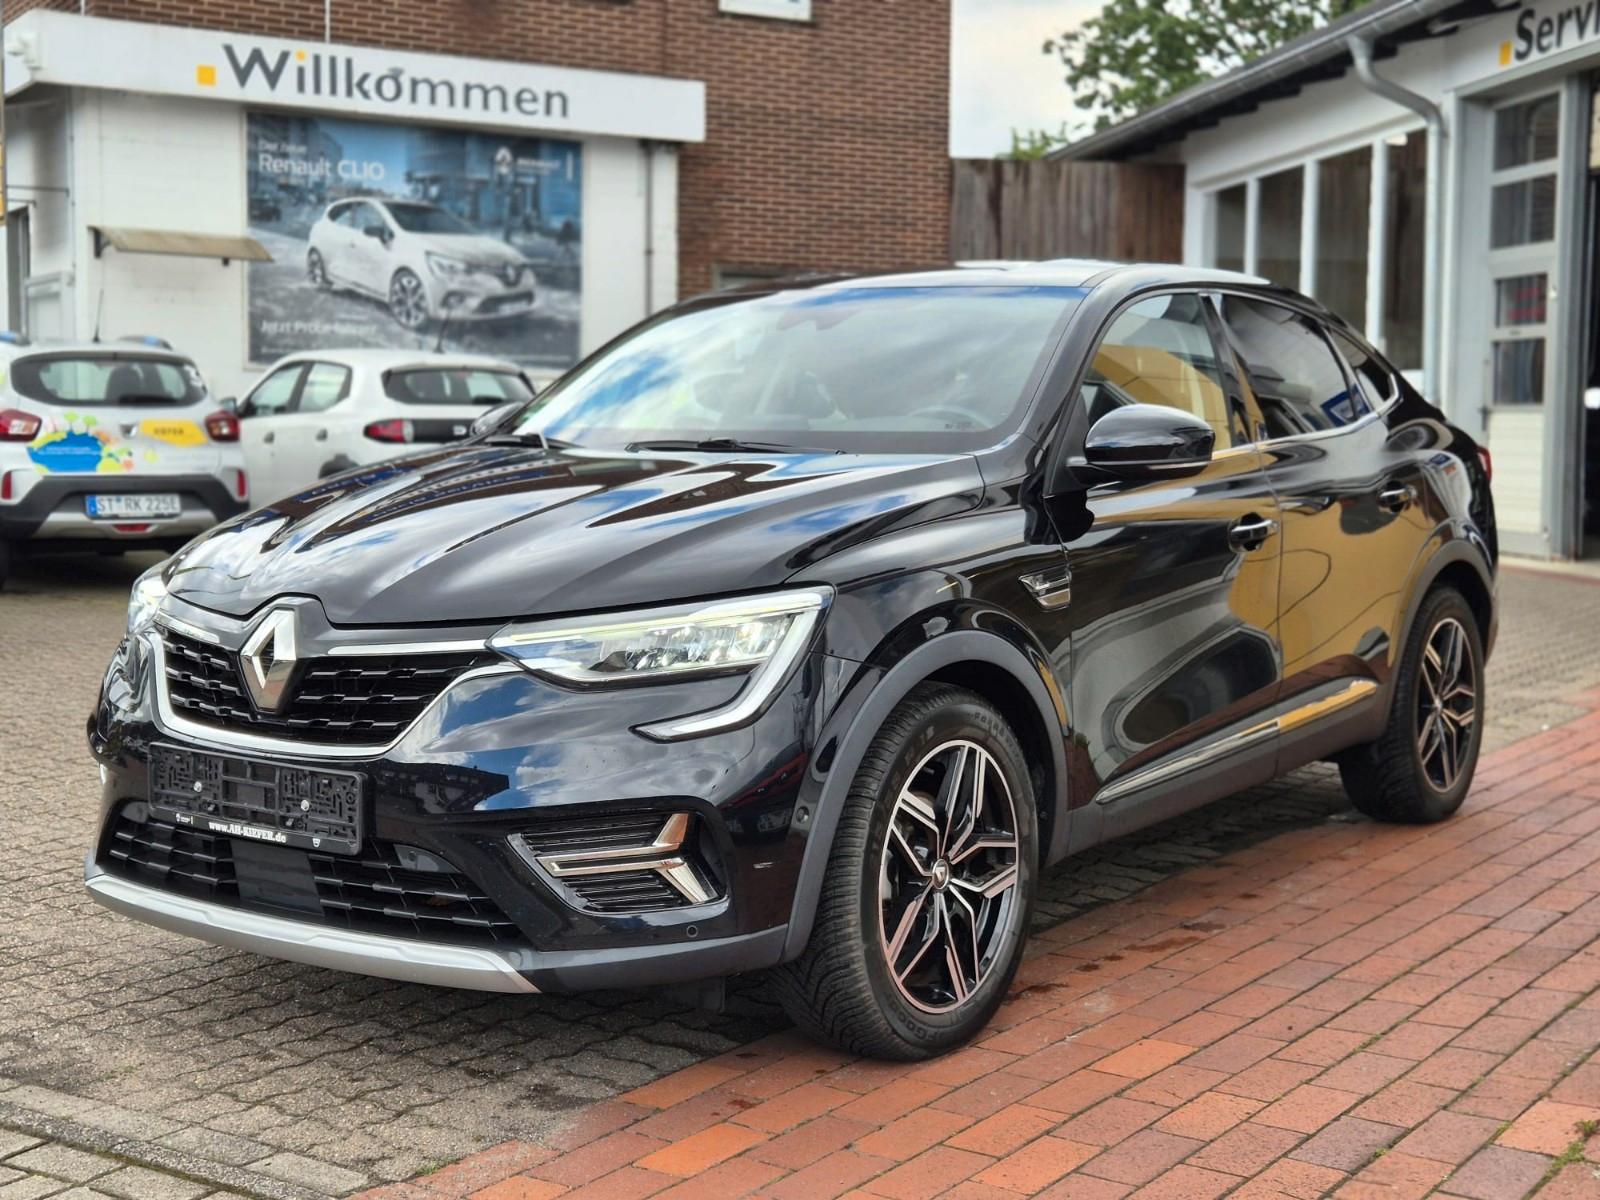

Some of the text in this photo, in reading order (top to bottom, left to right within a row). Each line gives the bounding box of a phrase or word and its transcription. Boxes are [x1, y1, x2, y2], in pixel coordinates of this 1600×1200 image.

[221, 43, 569, 118] Willkommen
[258, 152, 385, 180] Renault CLIO
